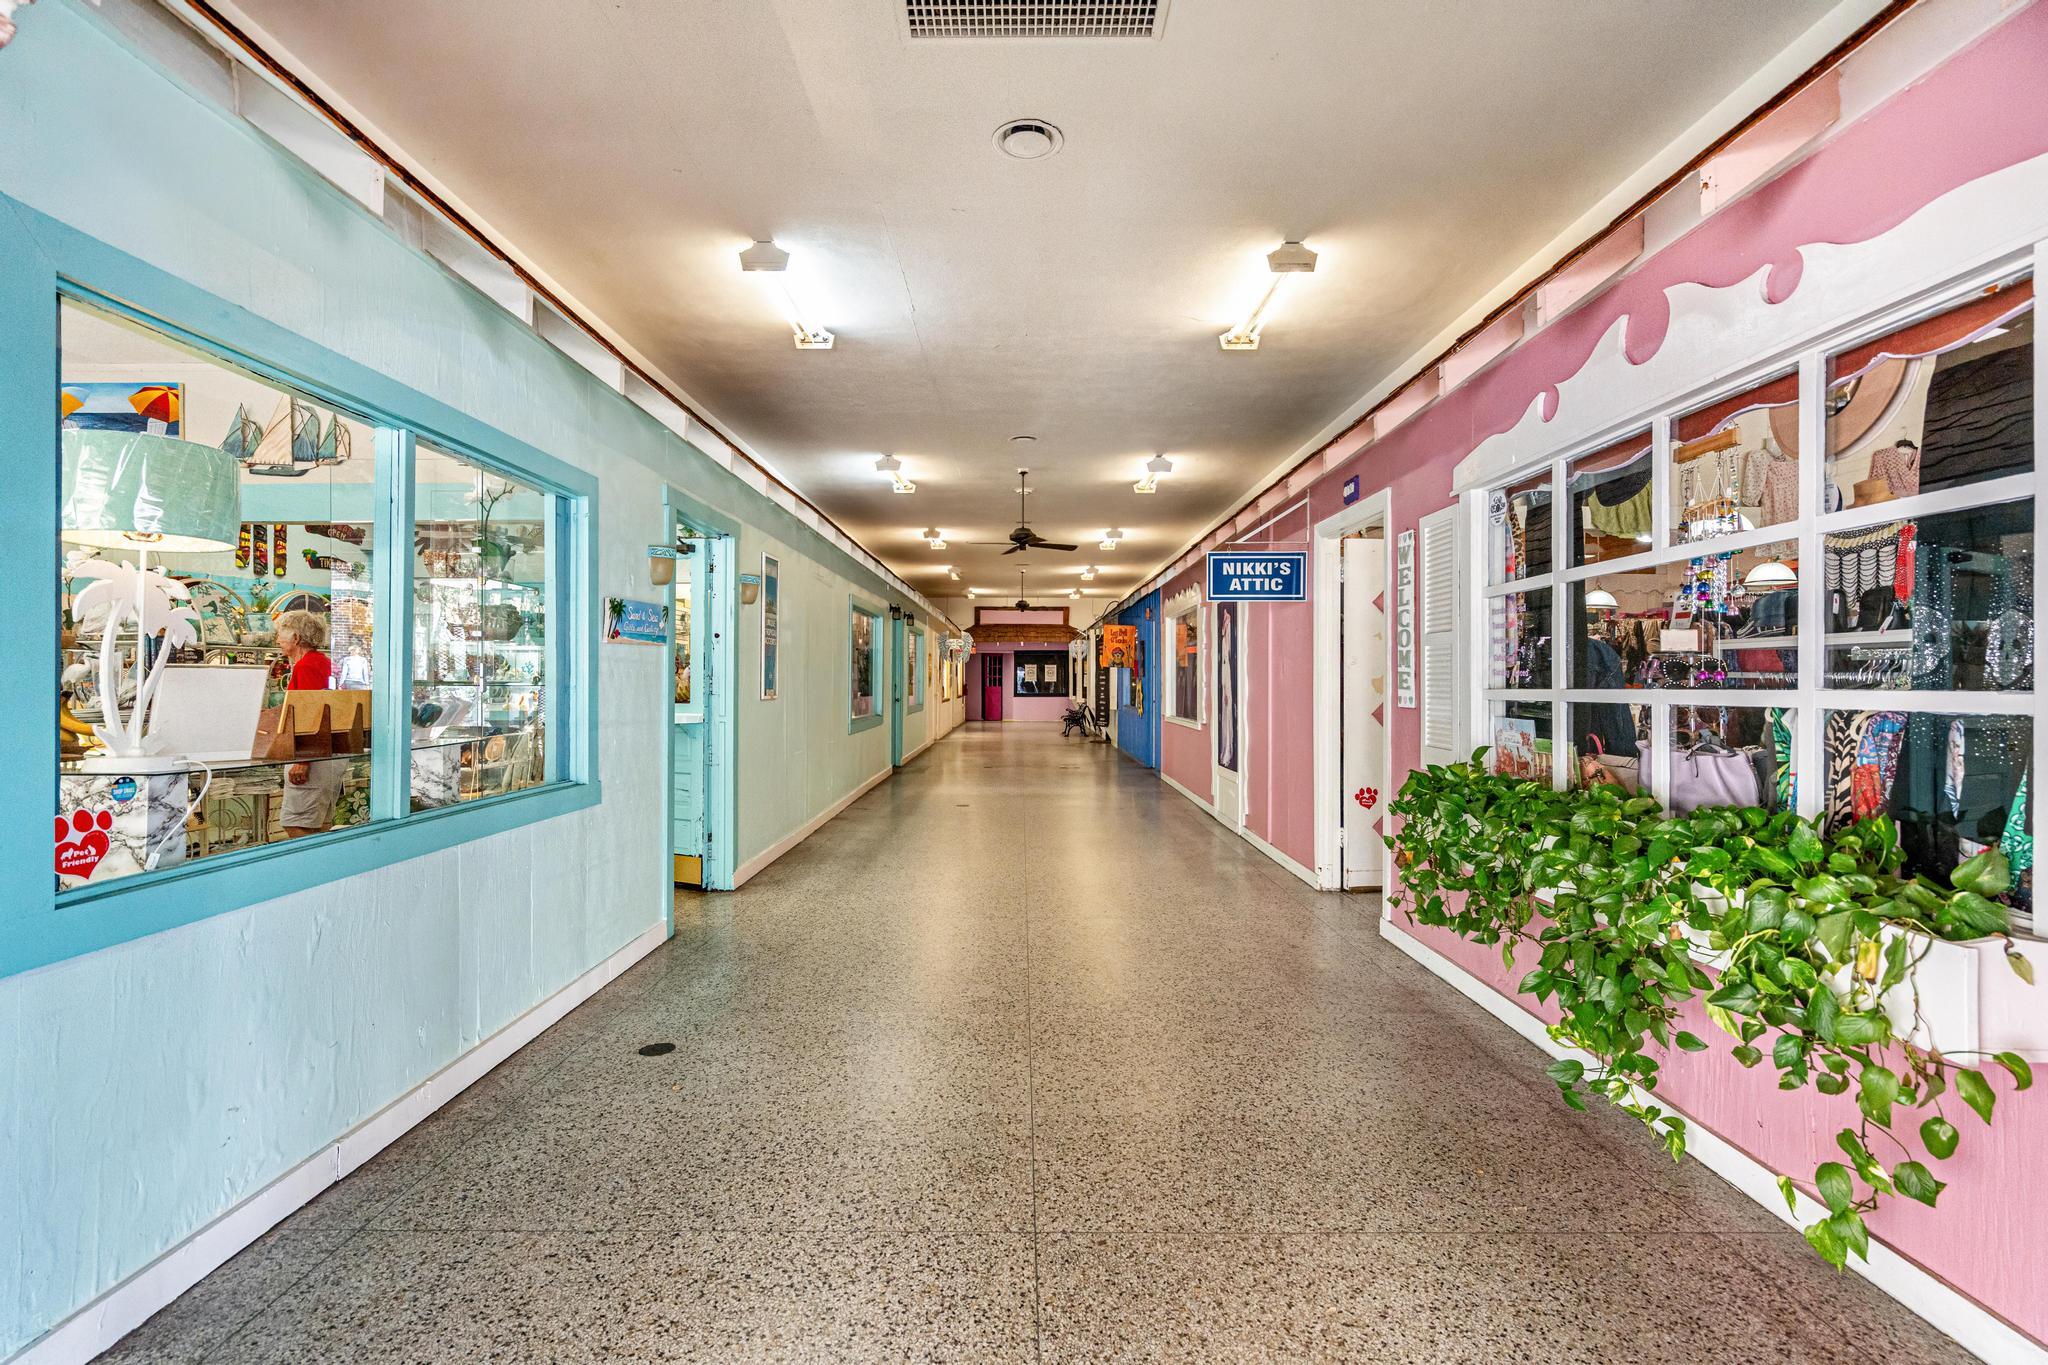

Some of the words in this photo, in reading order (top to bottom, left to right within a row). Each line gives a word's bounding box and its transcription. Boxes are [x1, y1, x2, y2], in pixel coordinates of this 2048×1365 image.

[327, 528, 347, 540] OPEN
[1222, 562, 1291, 575] NIKKI'S
[1229, 578, 1283, 591] ATTIC
[627, 606, 642, 620] Sand
[647, 608, 659, 622] Sea
[1397, 545, 1411, 691] WELCOME
[62, 856, 99, 868] Friendly
